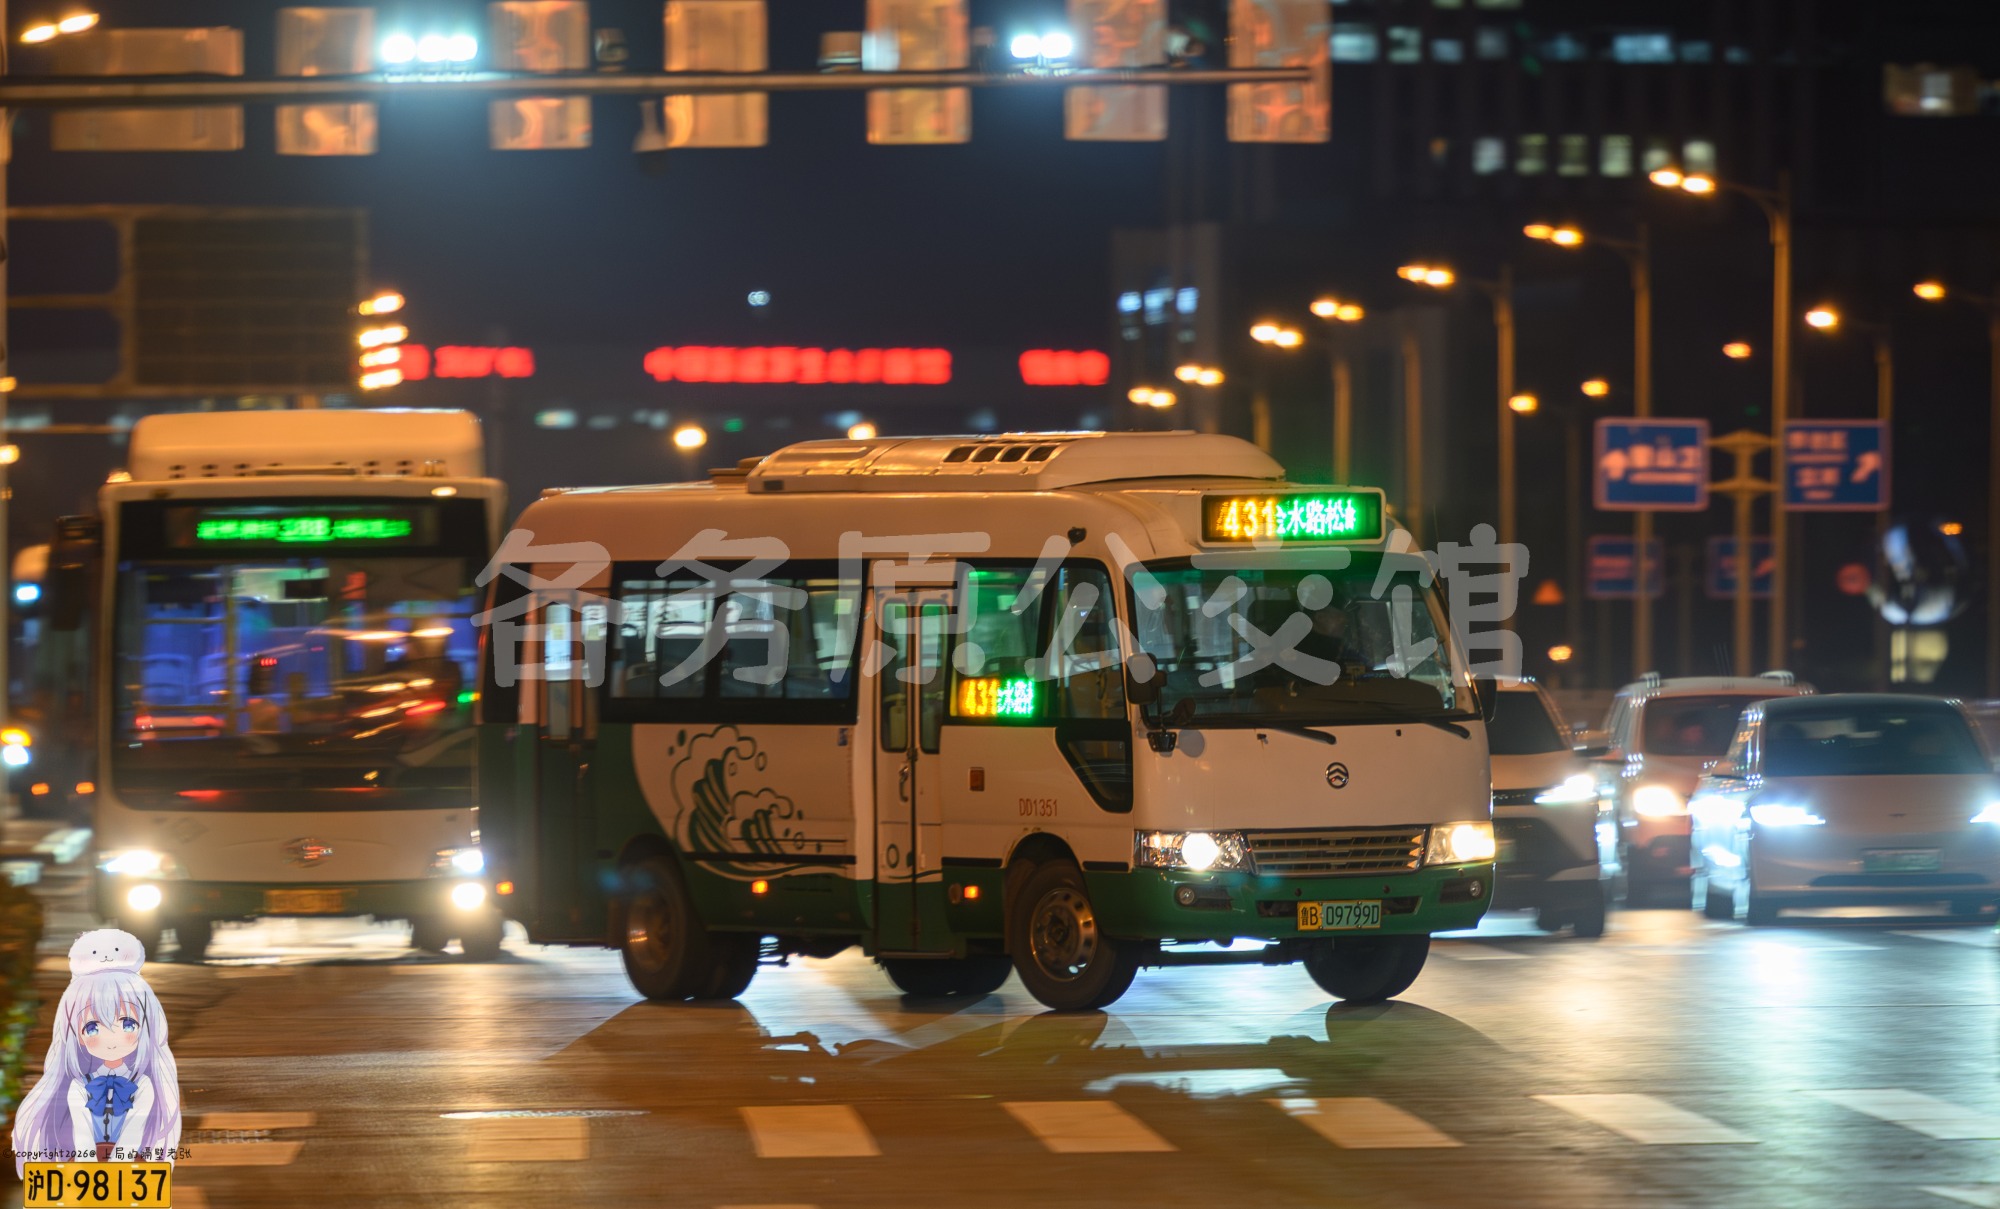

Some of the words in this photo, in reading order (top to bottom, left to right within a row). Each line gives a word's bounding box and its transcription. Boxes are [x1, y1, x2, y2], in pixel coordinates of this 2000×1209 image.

[1223, 500, 1276, 537] 431
[965, 680, 997, 715] 431
[1018, 798, 1058, 817] DD1351
